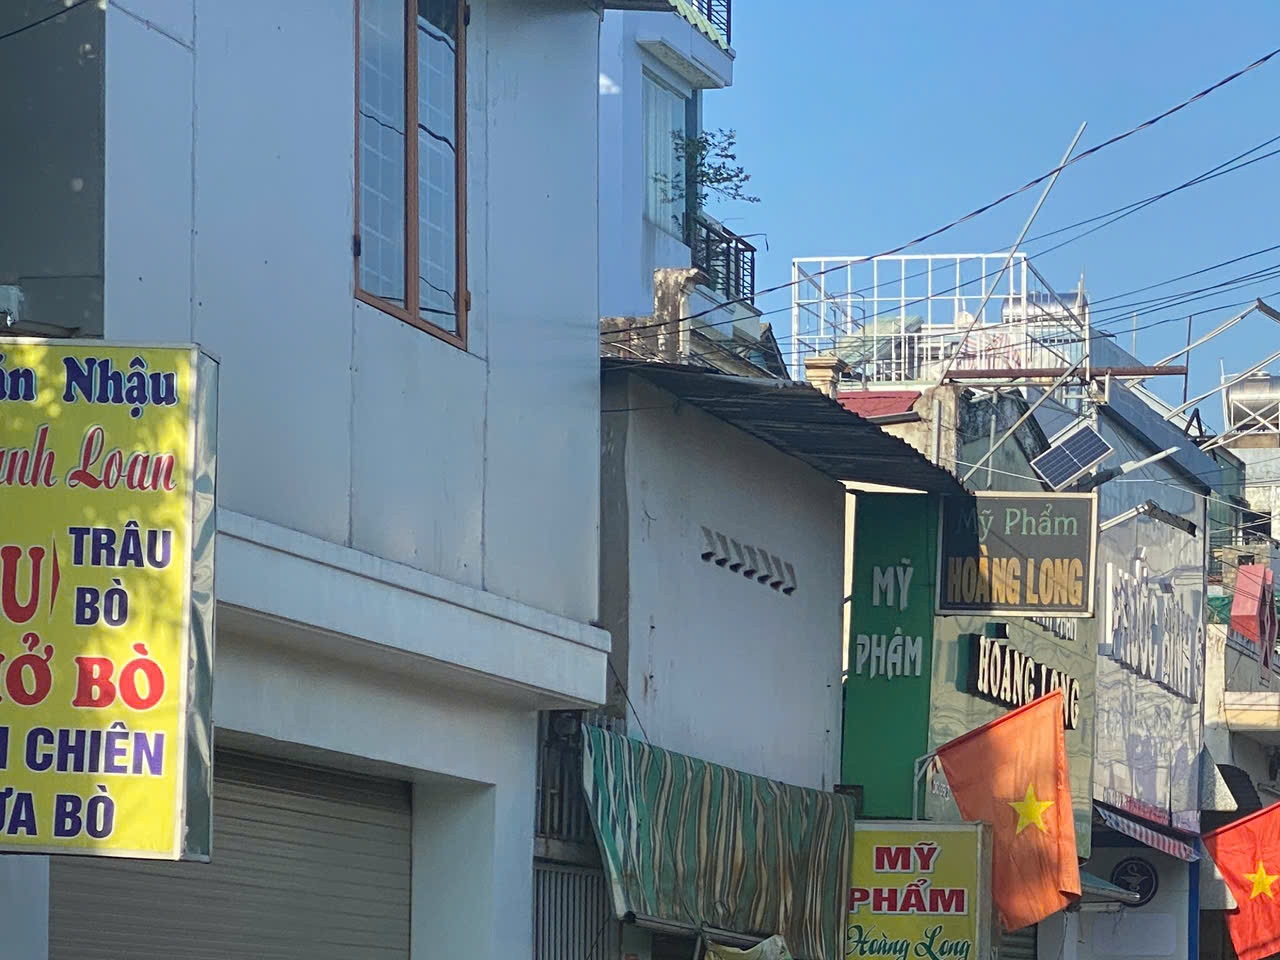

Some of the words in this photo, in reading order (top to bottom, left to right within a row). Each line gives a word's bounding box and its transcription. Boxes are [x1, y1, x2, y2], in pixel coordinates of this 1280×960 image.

[63, 356, 177, 417] Nhậu
[69, 427, 176, 490] Loan
[69, 520, 172, 568] TRÂU
[1004, 503, 1078, 537] Phẩm
[872, 557, 914, 612] MỸ
[948, 544, 1021, 605] HOÀNG
[1026, 557, 1084, 606] LONG
[76, 579, 128, 626] BÒ
[72, 642, 165, 710] BÒ
[978, 623, 1036, 706] HOÀNG
[26, 722, 165, 776] CHIÊN
[54, 785, 115, 838] BÒ
[875, 842, 937, 870] MỸ
[849, 879, 965, 912] PHẨM
